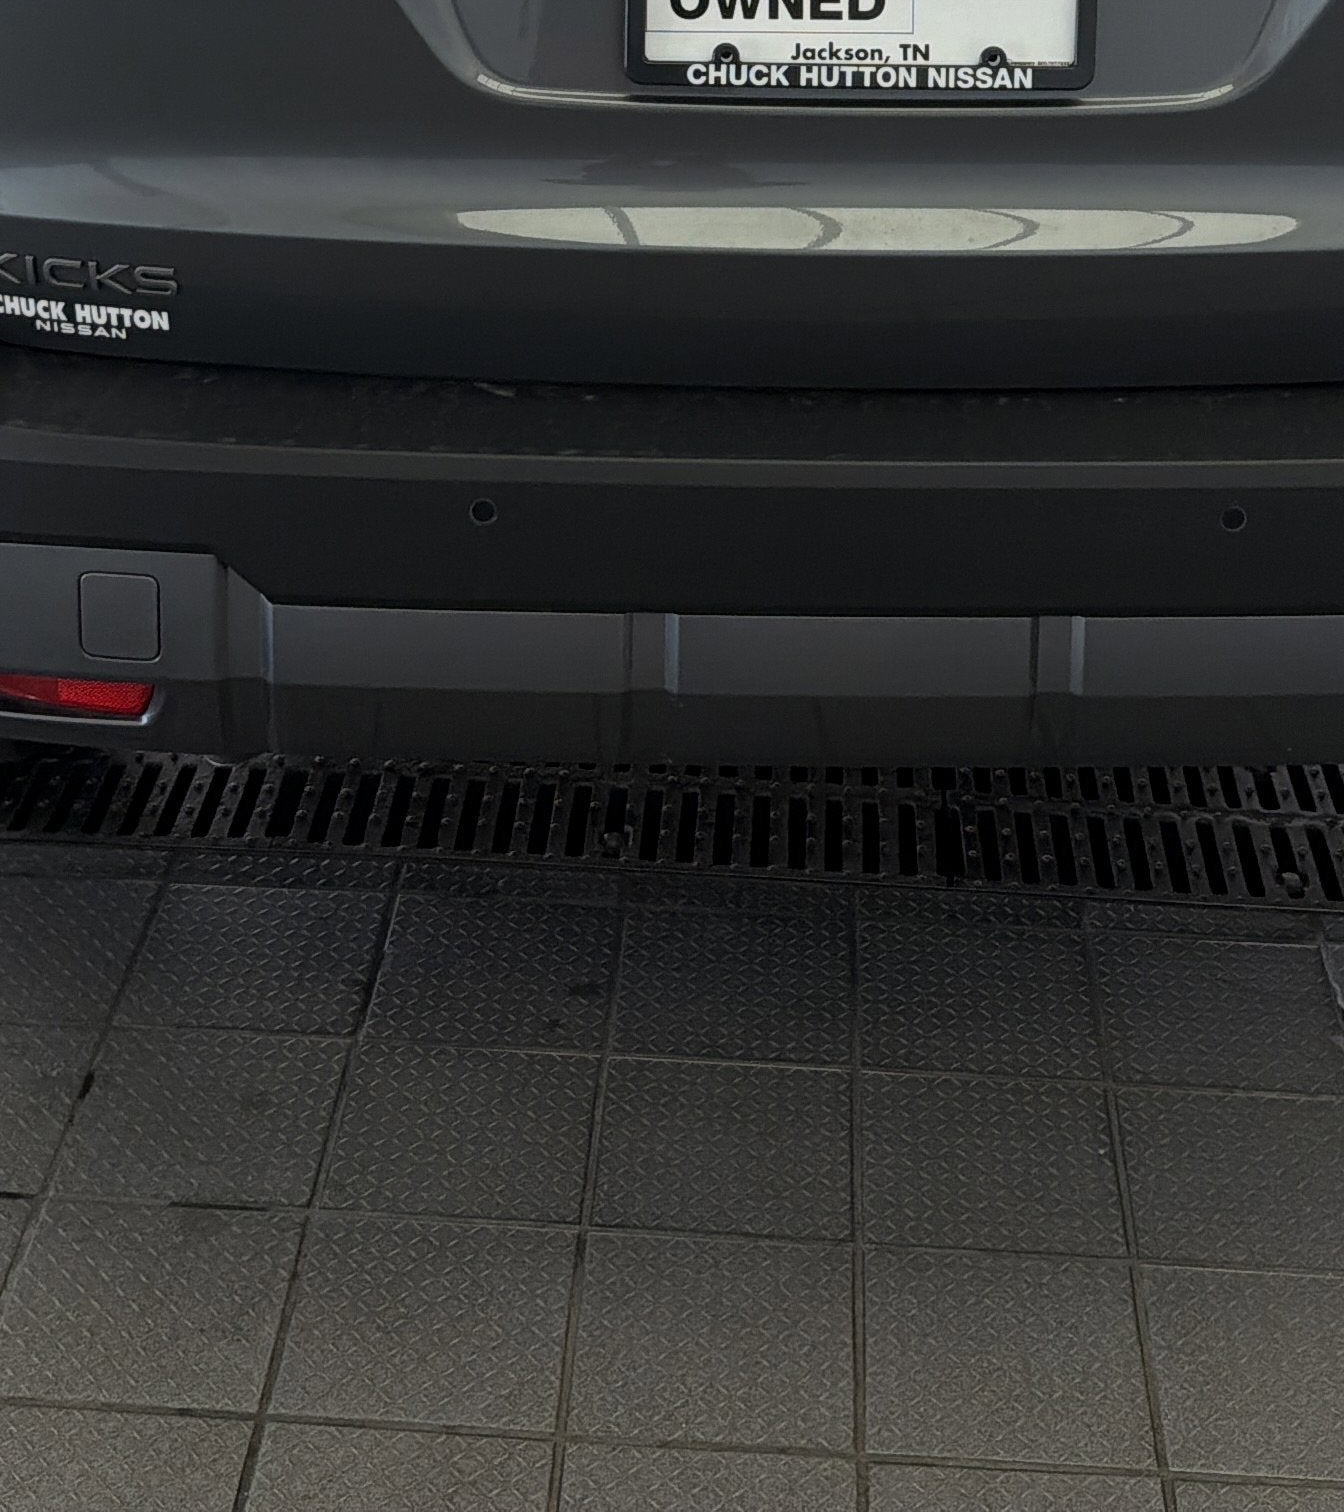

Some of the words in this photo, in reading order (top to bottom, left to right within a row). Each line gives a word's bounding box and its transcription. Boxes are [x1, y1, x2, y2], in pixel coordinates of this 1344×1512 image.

[790, 41, 890, 63] Jackson,
[899, 43, 930, 61] TN
[687, 64, 789, 87] CHUCK
[799, 66, 918, 88] HUTTON
[927, 66, 1033, 89] NISSAN
[75, 303, 169, 331] HUTTON
[36, 320, 127, 339] NISSAN
